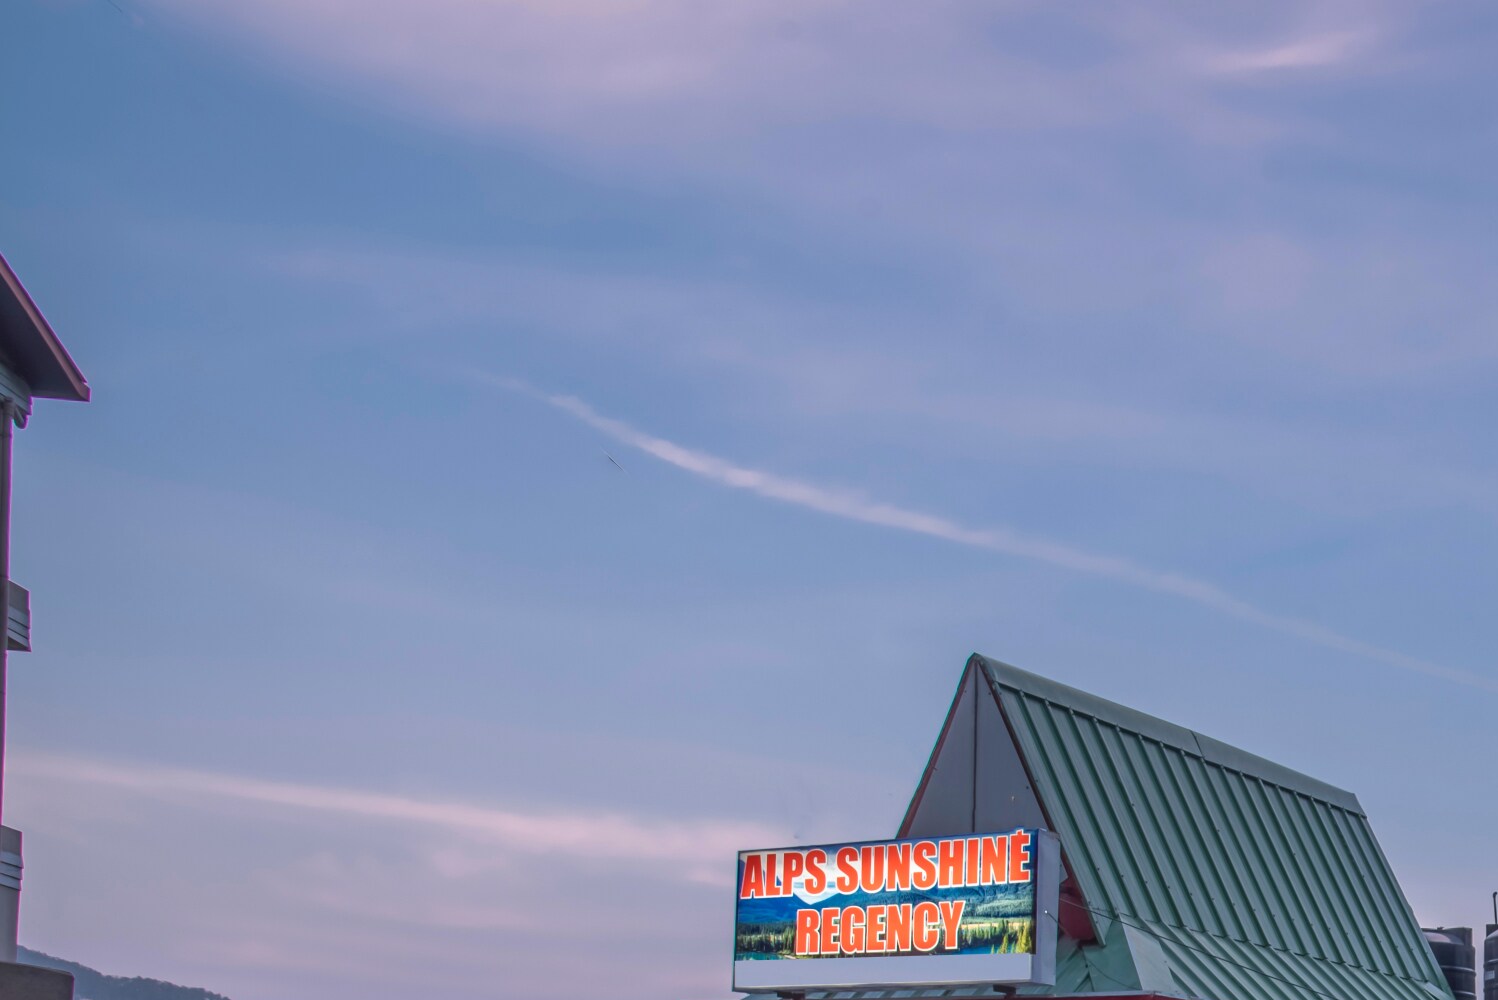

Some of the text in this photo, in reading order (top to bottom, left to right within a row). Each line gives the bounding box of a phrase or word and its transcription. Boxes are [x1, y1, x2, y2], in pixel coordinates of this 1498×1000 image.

[740, 832, 1032, 899] ALPS SUNSHINE
[796, 902, 966, 956] REGENCY
